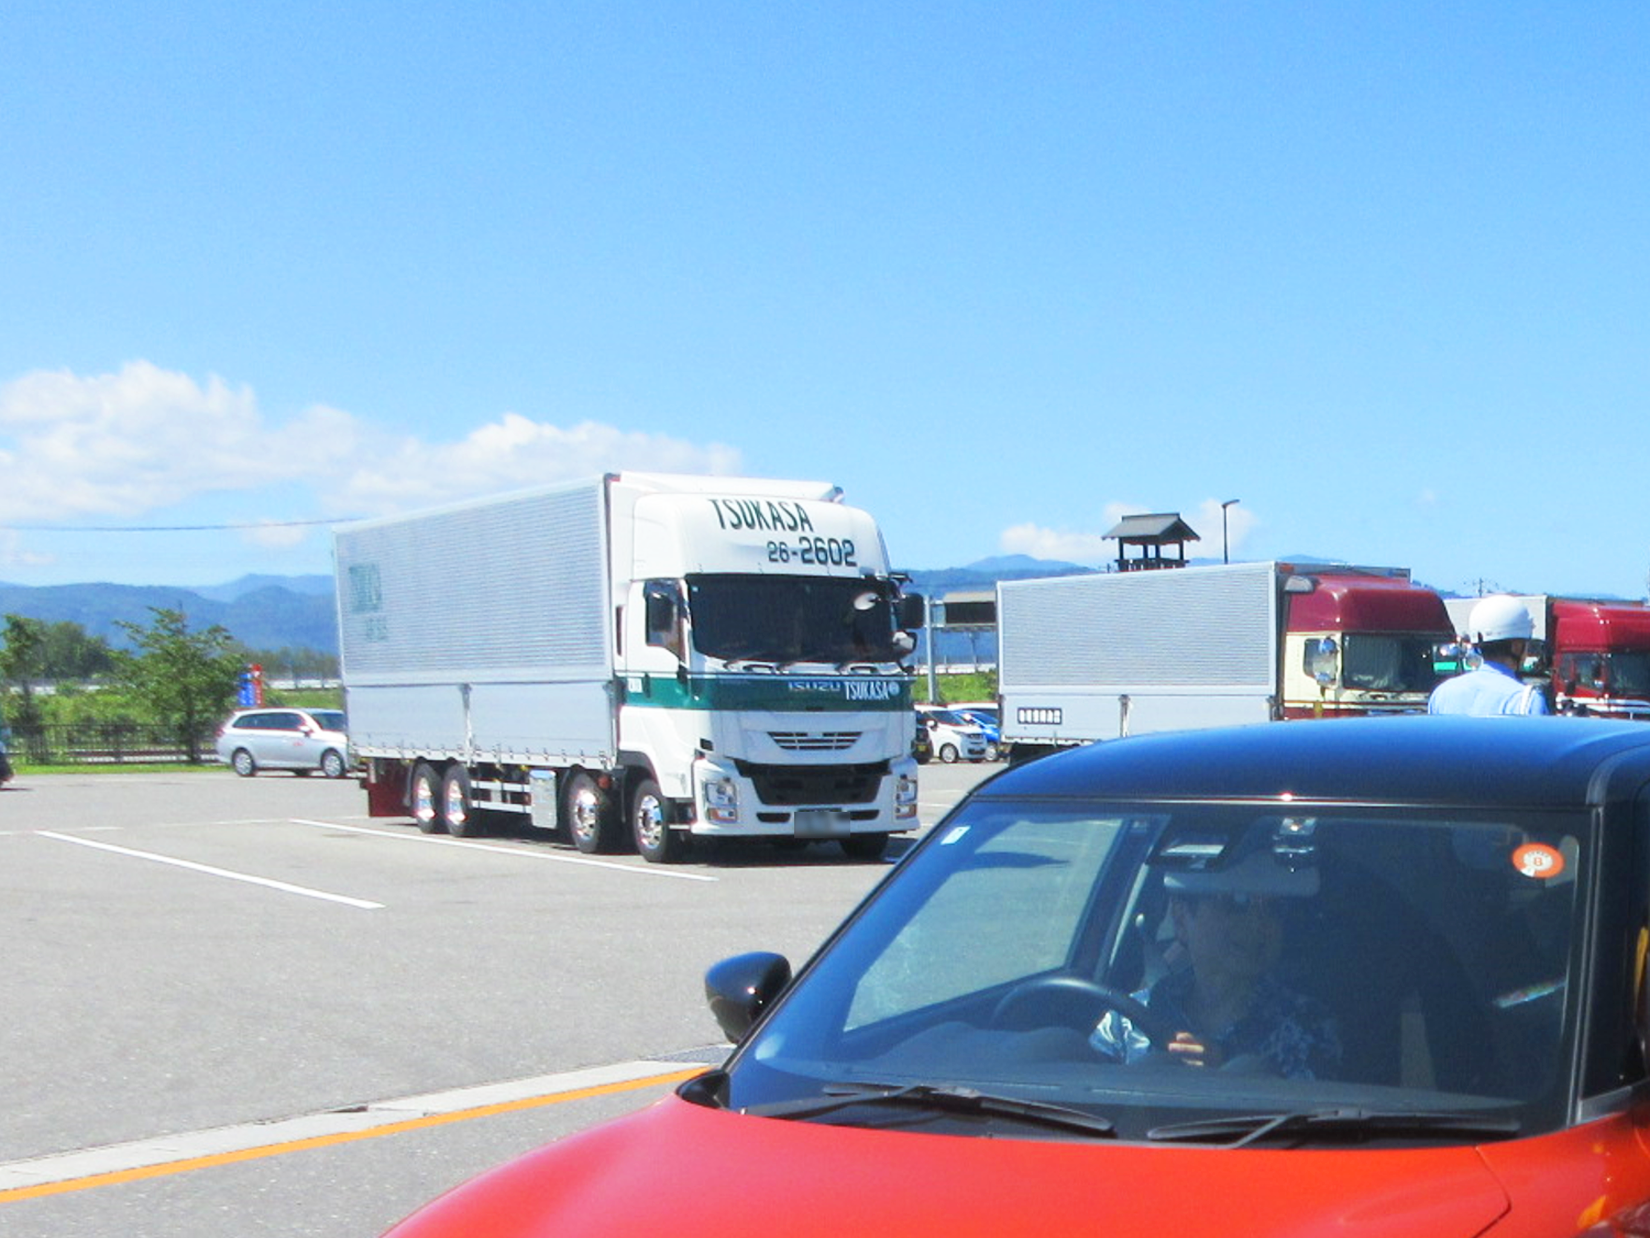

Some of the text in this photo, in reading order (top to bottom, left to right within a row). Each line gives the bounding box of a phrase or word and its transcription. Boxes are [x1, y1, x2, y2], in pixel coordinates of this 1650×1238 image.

[707, 499, 814, 532] TSUKASA
[766, 536, 858, 567] 26-2602
[844, 681, 890, 700] TSUKASA
